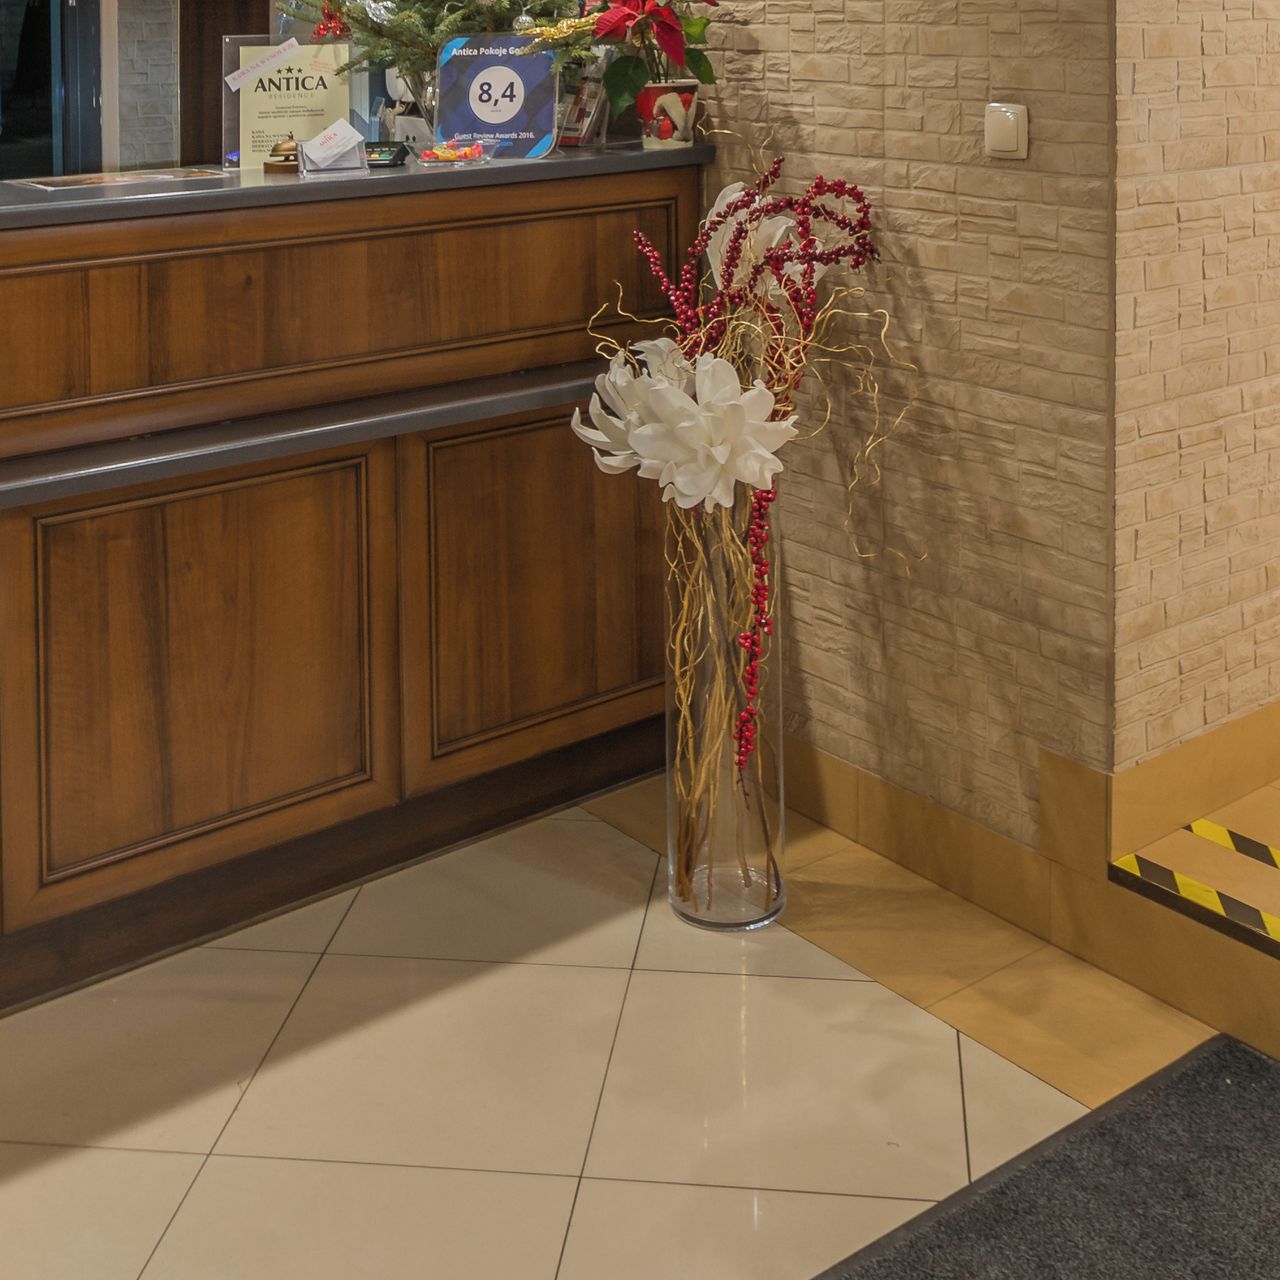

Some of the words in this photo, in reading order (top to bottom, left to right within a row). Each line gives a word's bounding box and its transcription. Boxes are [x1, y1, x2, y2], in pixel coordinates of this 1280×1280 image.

[451, 47, 478, 57] Antica
[480, 47, 508, 57] Pokoje
[254, 75, 328, 92] ANTICA
[478, 81, 516, 107] 8,4
